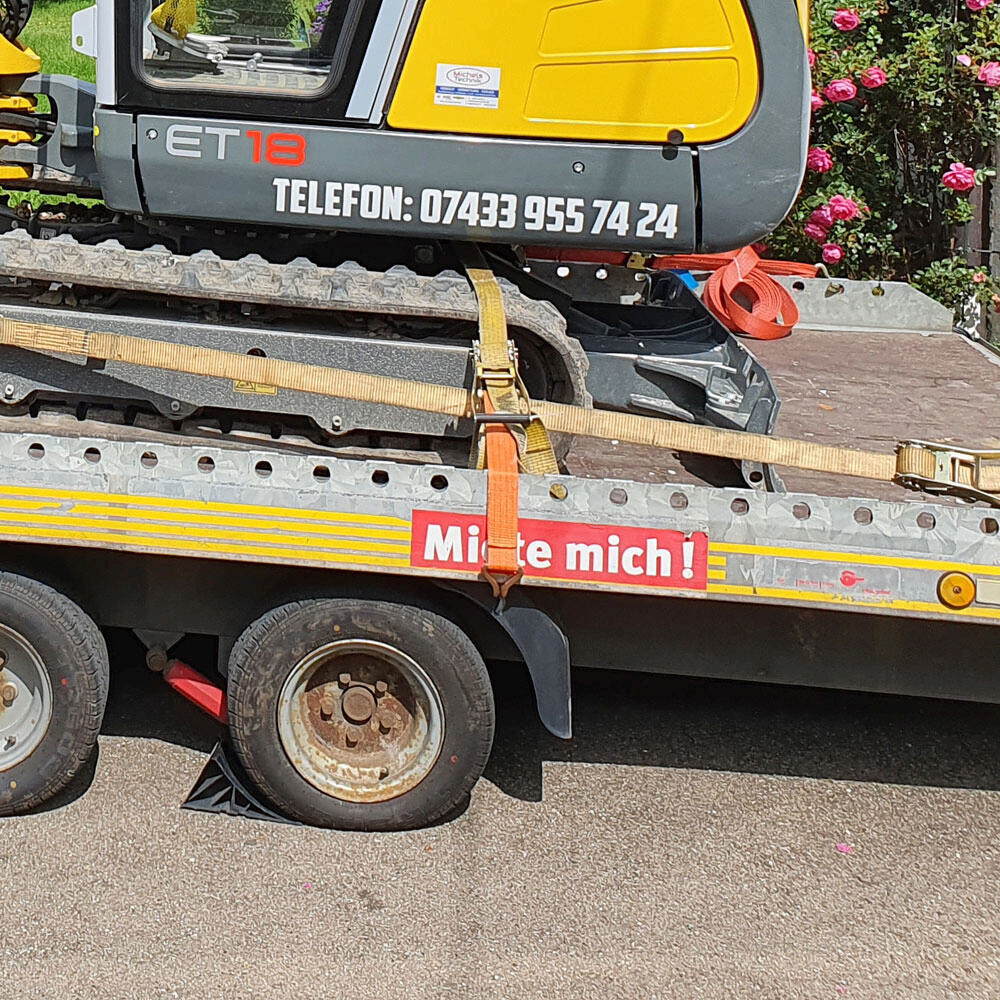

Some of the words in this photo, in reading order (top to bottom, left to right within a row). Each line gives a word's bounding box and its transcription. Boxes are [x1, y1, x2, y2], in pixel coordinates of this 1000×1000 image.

[272, 178, 414, 222] TELEFON:
[420, 188, 518, 229] 07433
[524, 195, 585, 233] 955
[590, 199, 630, 237] 74
[635, 202, 679, 239] 24
[424, 524, 552, 569] Mite
